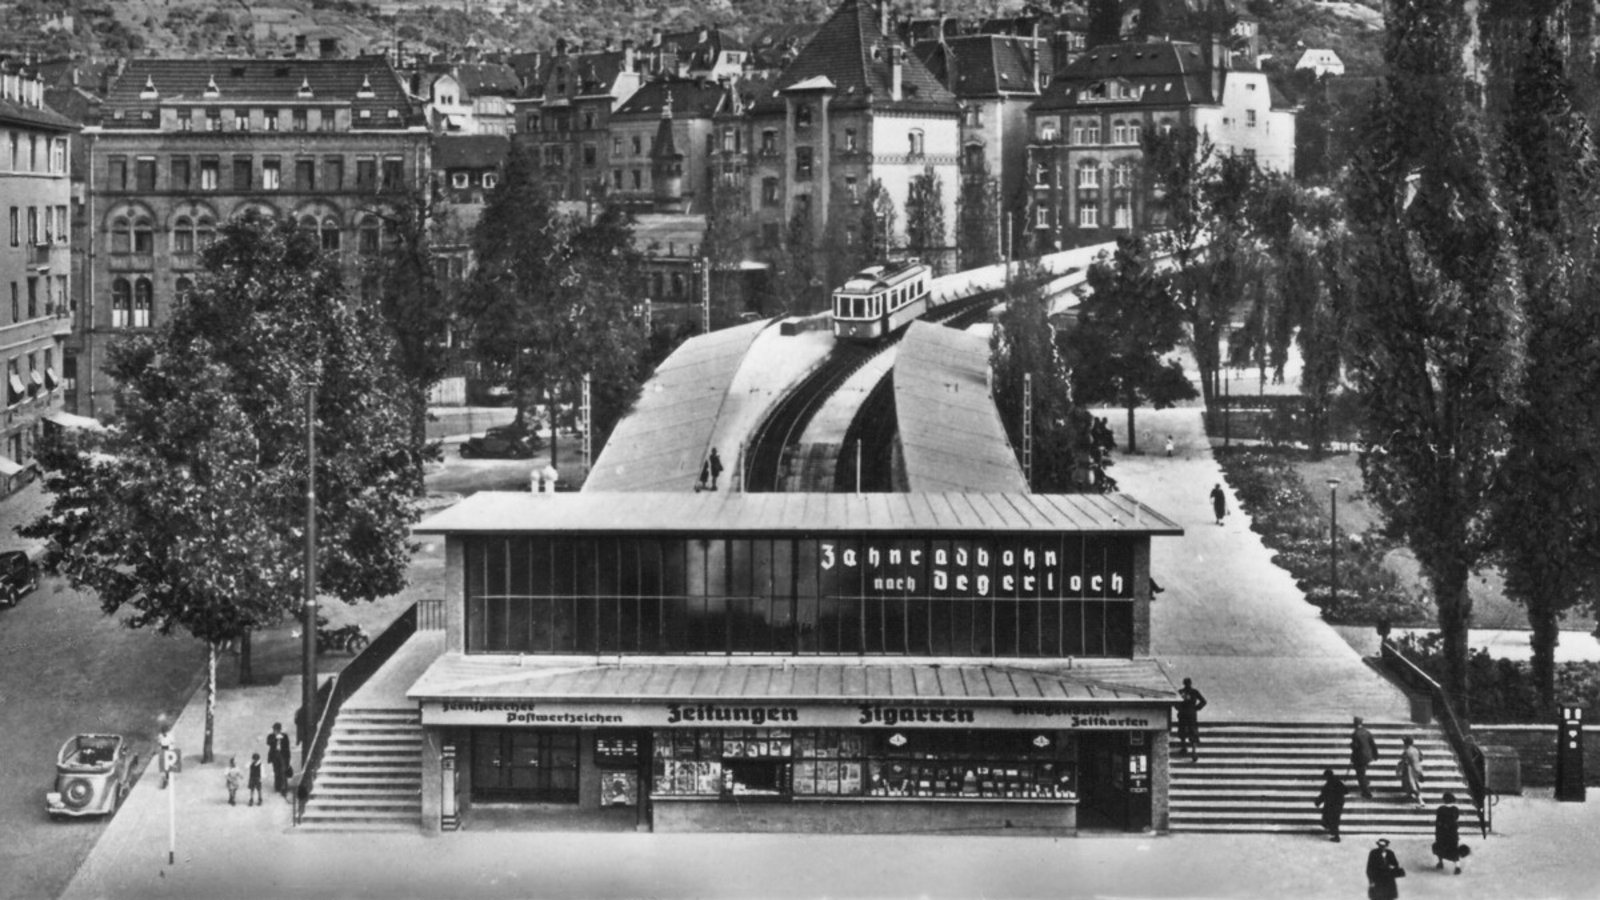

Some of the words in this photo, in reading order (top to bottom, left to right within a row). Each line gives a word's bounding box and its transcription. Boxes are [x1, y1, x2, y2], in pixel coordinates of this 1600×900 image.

[821, 544, 1057, 569] Zahnradbahn
[874, 576, 915, 592] nach
[933, 569, 1123, 596] Degerloch
[667, 703, 798, 724] Zeitungen
[858, 703, 975, 725] Zigarren
[1071, 716, 1149, 727] Zeitkarten
[164, 750, 177, 771] P
